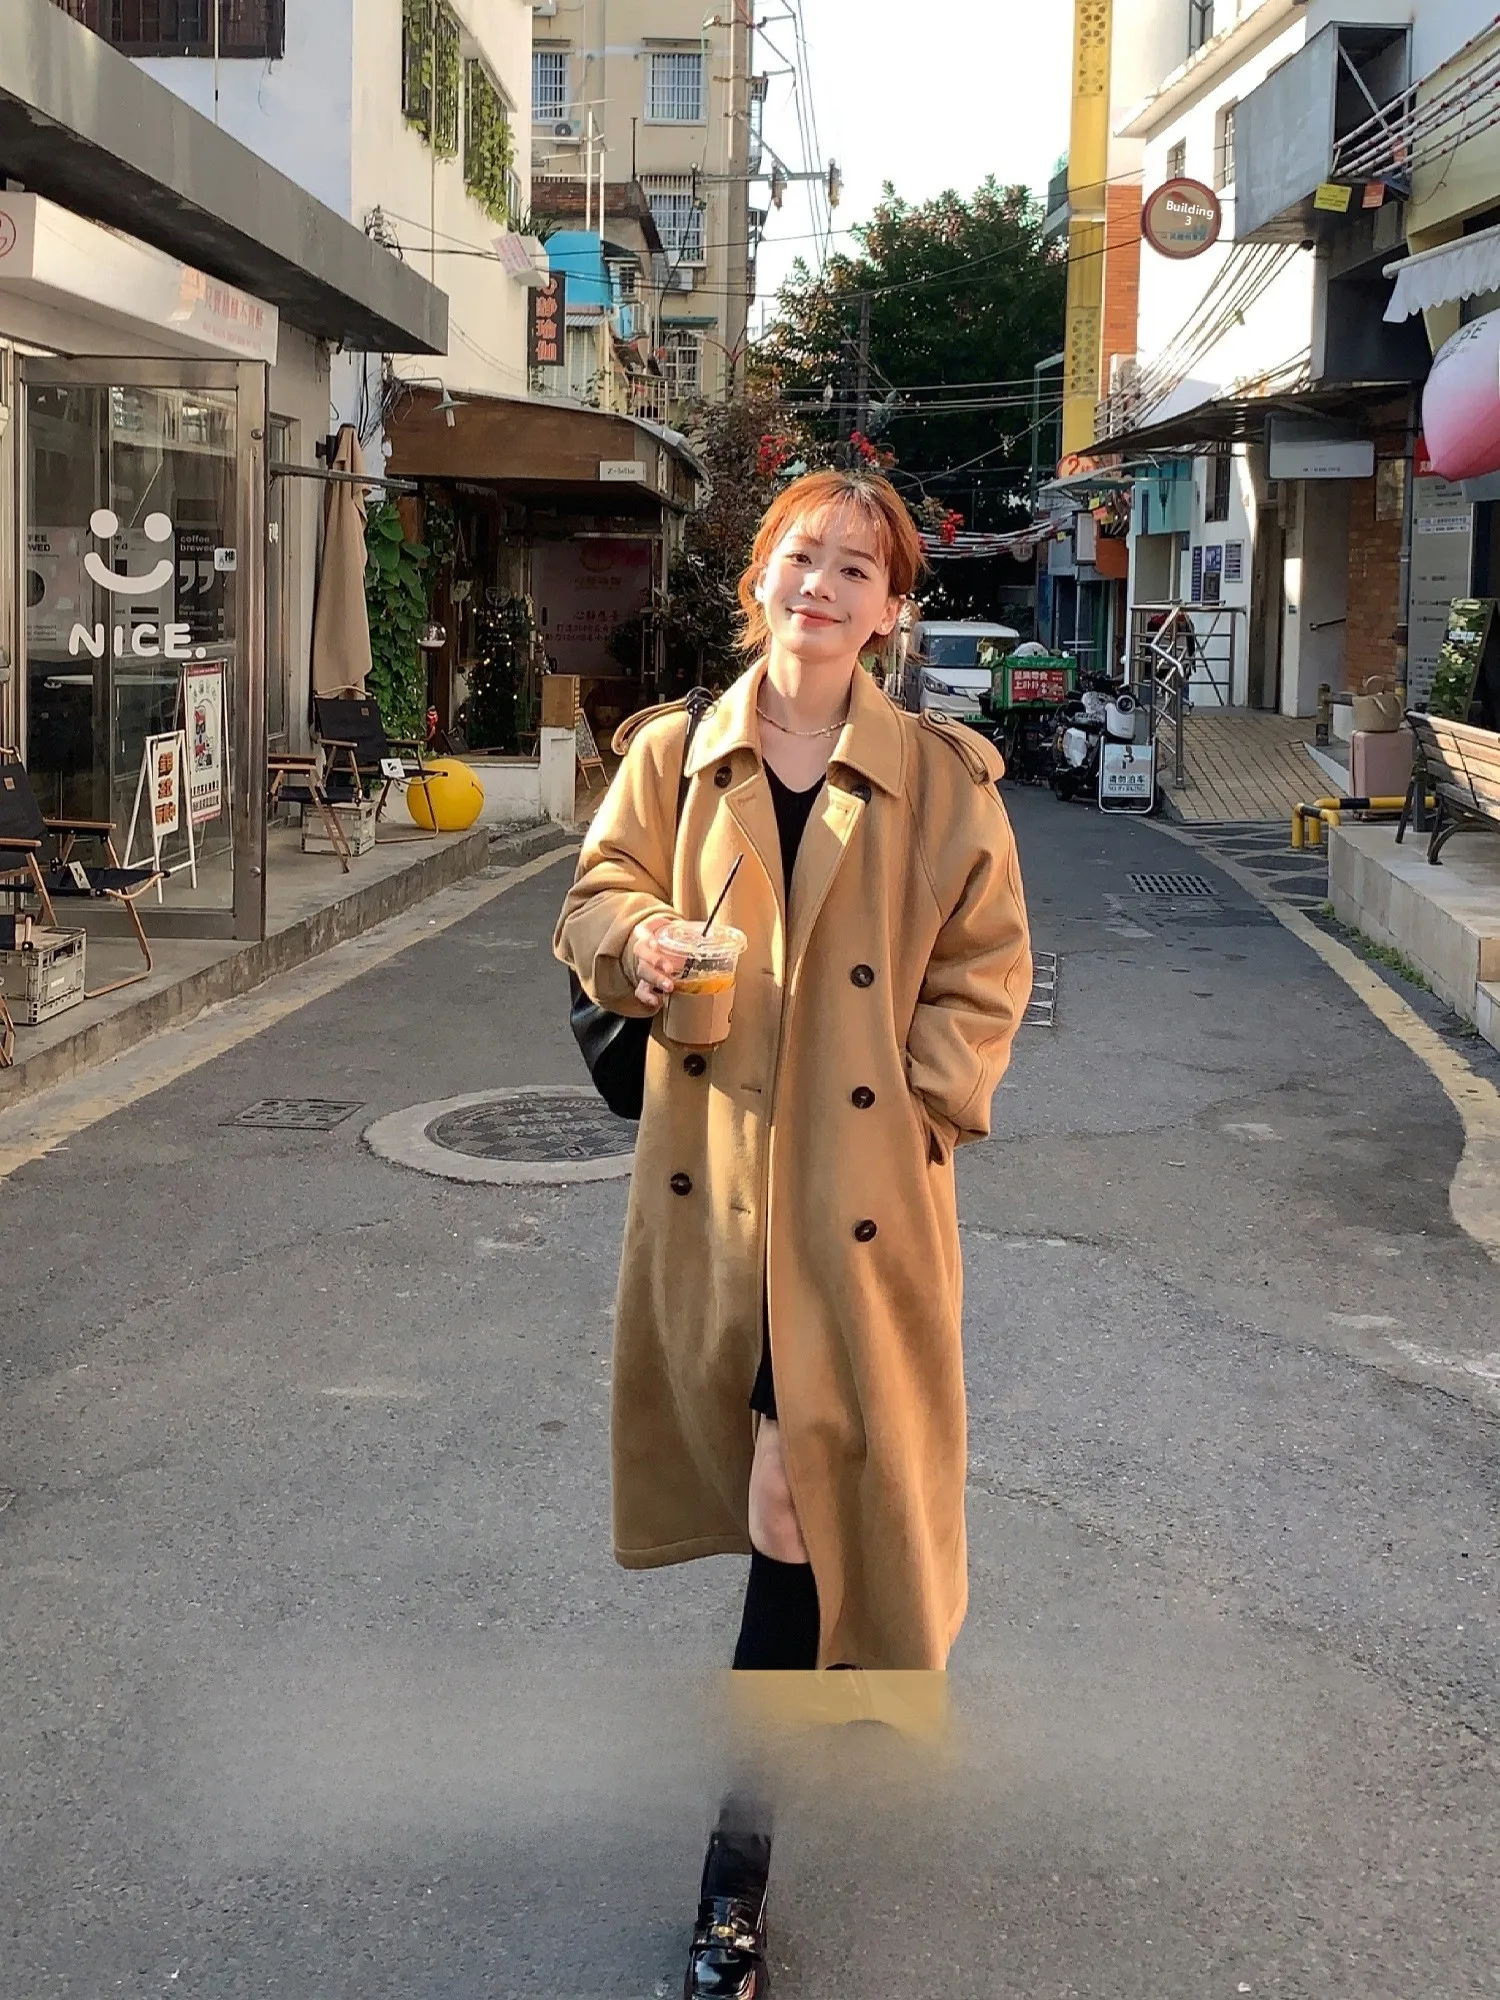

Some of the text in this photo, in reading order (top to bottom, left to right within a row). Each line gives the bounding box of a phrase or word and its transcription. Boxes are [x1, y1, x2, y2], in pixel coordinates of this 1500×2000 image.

[1166, 200, 1214, 220] Building
[1184, 215, 1193, 226] 3
[180, 534, 210, 543] coffee
[180, 544, 216, 552] brewed
[68, 622, 207, 659] NICE.
